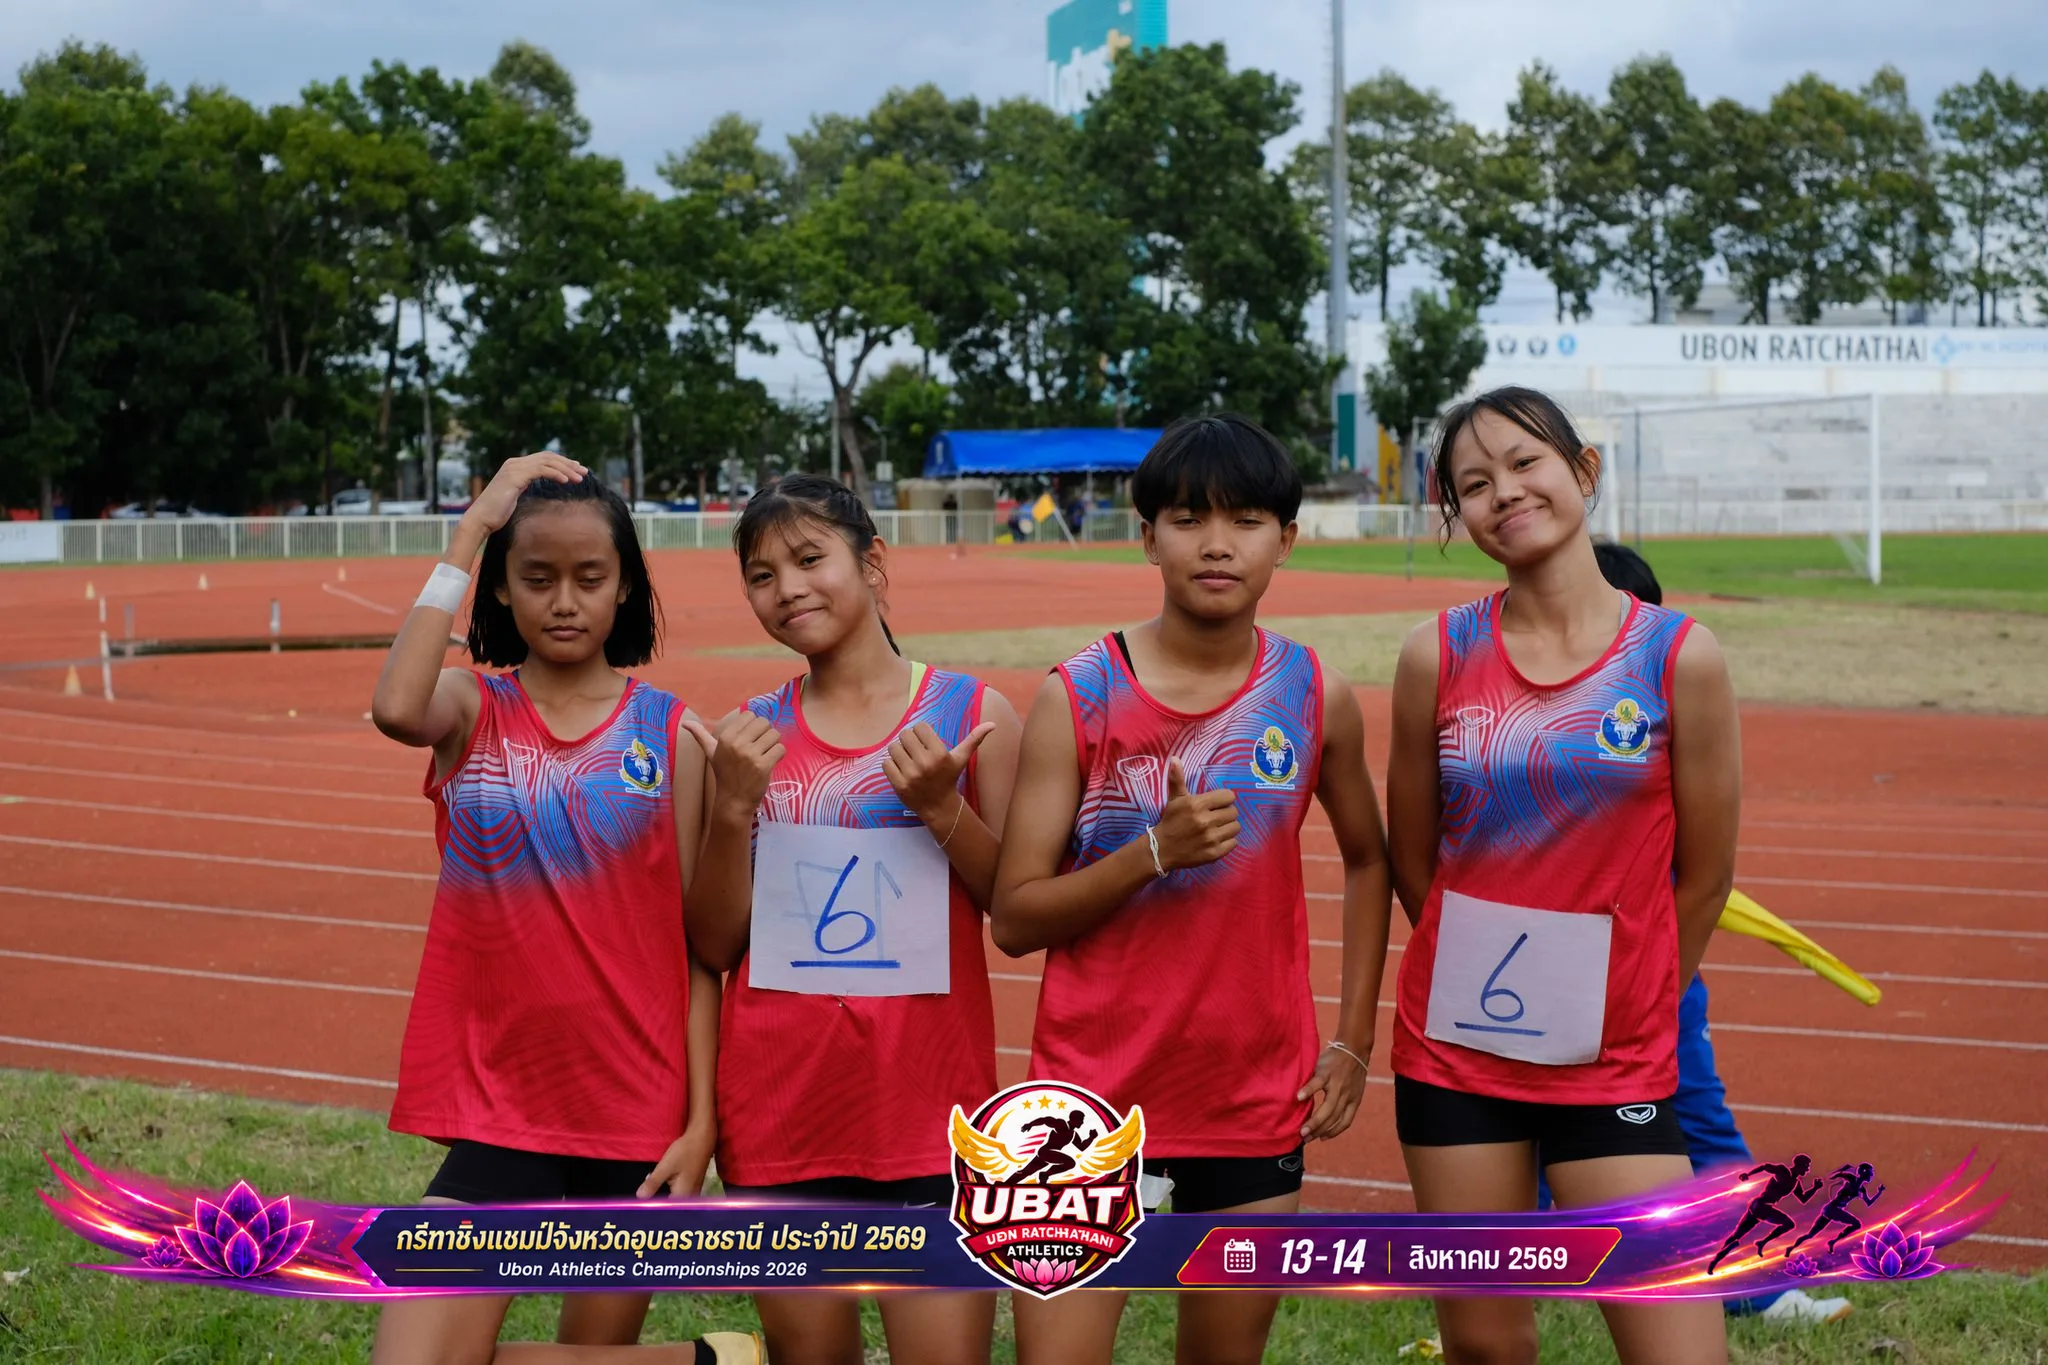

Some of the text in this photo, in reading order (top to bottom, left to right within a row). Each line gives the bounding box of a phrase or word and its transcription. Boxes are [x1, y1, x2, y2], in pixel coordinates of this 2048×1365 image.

[1681, 334, 1757, 361] UBON
[815, 855, 876, 955] 6
[1480, 933, 1528, 1023] 6
